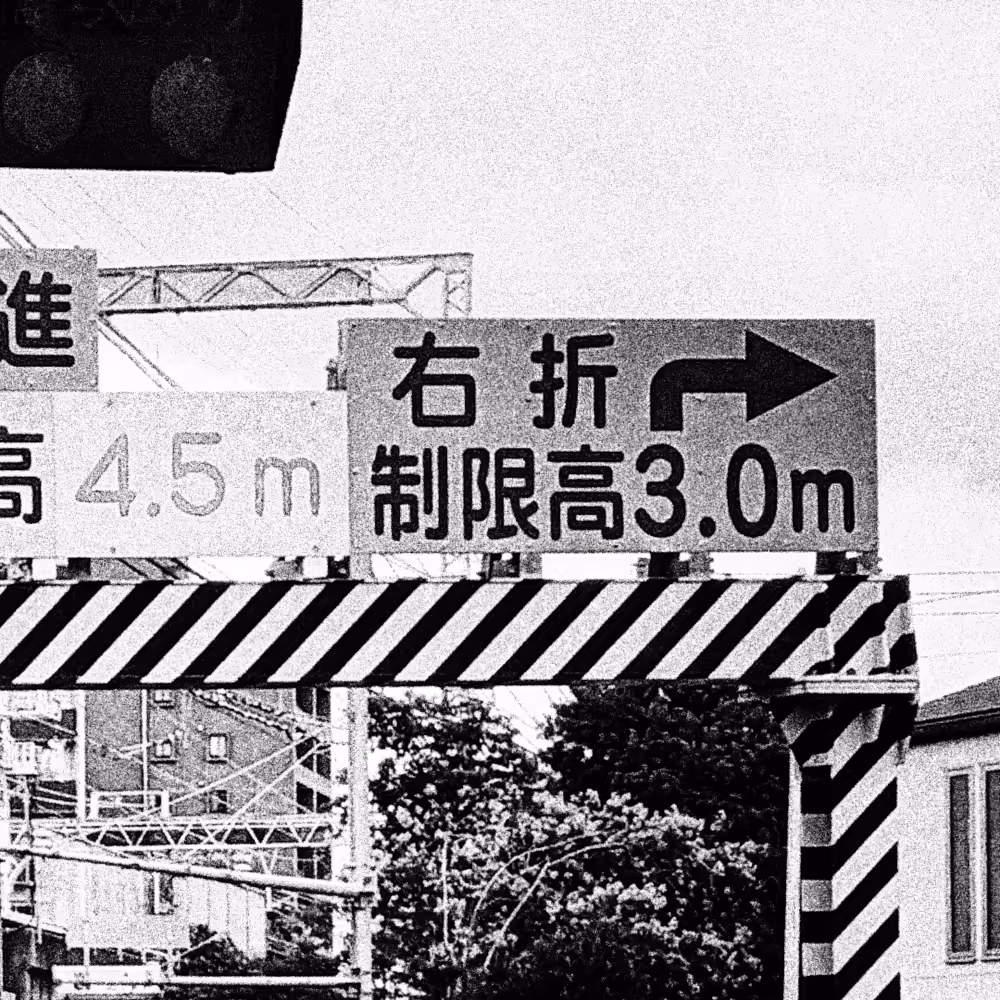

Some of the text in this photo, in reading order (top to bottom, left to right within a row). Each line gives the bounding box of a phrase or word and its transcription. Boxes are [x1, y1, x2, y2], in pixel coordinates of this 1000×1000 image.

[393, 331, 618, 429] 右折
[371, 443, 856, 540] 制限高3.0m
